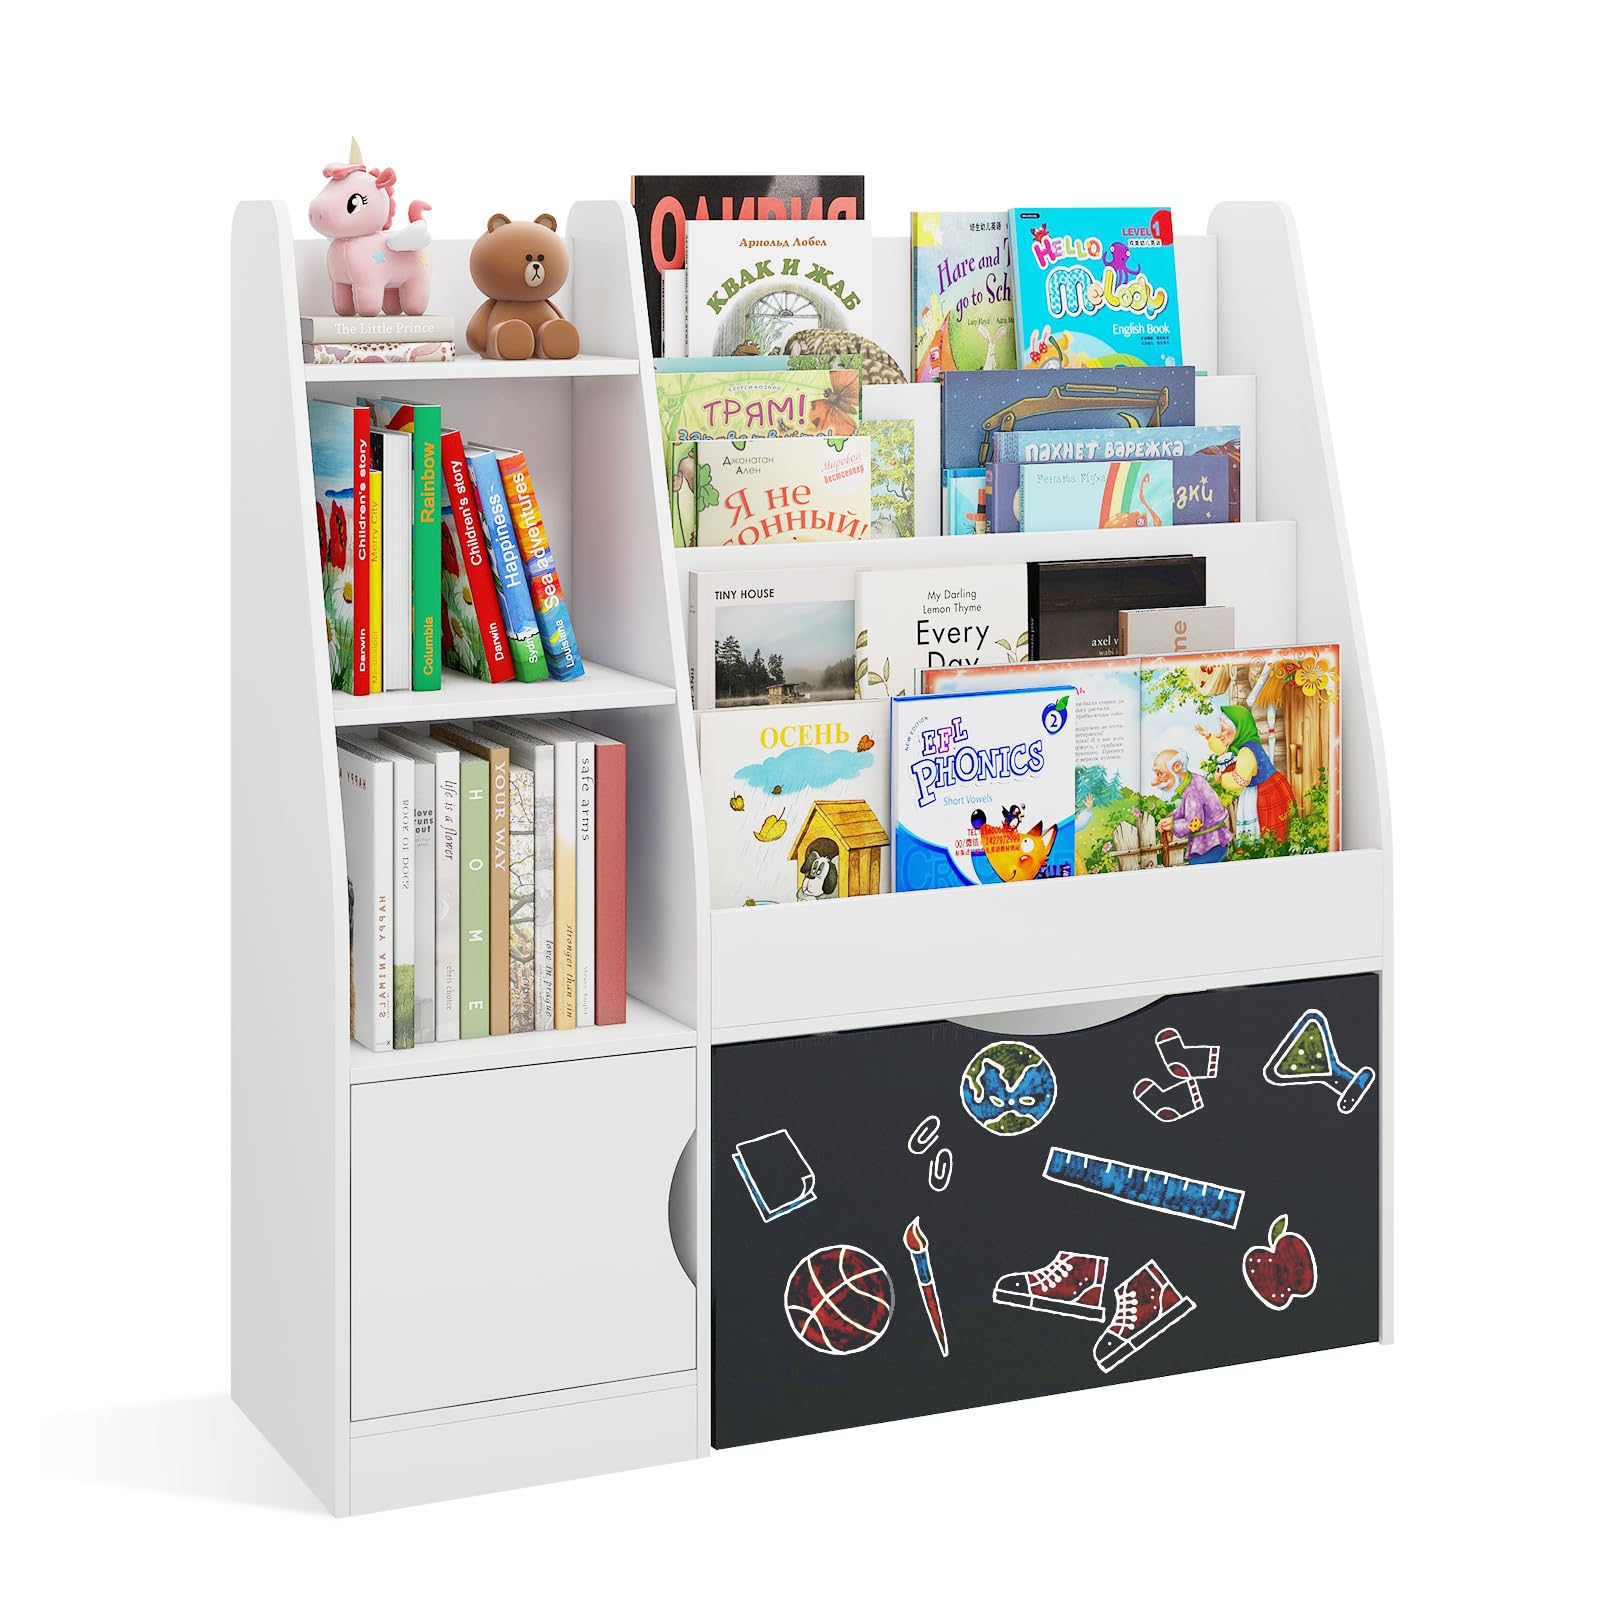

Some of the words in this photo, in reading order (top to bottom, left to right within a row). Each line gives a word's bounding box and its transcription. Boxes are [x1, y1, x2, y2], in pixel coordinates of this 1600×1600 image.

[739, 238, 790, 248] Арнольд
[793, 236, 827, 247] Лобел
[1122, 227, 1151, 236] LEVEL
[1033, 237, 1101, 267] HELLO
[706, 259, 775, 315] КВАК
[781, 258, 801, 276] И
[804, 262, 862, 311] ЖАБ
[937, 257, 976, 295] Hare
[978, 246, 1000, 270] and
[956, 296, 969, 322] go
[971, 287, 983, 306] to
[335, 323, 357, 335] The
[360, 322, 393, 334] Little
[396, 322, 435, 334] Prince
[1112, 322, 1145, 338] English
[1147, 322, 1170, 335] Book
[703, 394, 806, 428] ТРЯМ!
[359, 438, 368, 478] story
[722, 456, 775, 466] Джонатан
[420, 442, 435, 523] Rainbow
[451, 460, 466, 494] story
[358, 482, 367, 561] Children's
[512, 472, 555, 569] adventures
[724, 487, 756, 528] Я
[764, 484, 811, 510] не
[460, 497, 482, 566] Children's
[723, 510, 868, 545] онный!
[542, 573, 560, 609] Sea
[714, 590, 737, 600] TINY
[740, 588, 775, 600] HOUSE
[927, 591, 941, 602] My
[944, 588, 977, 600] Darling
[923, 604, 951, 614] Lemon
[954, 602, 982, 615] Thyme
[423, 616, 434, 676] Columbia
[488, 622, 505, 661] Darwin
[556, 619, 575, 668] Louisiana
[917, 619, 990, 651] Every
[1091, 635, 1111, 647] axel
[759, 722, 850, 750] ОСЕНЬ
[922, 716, 969, 757] EFL
[1050, 713, 1058, 728] 2
[440, 780, 457, 798] life
[581, 758, 595, 792] safe
[911, 739, 1045, 808] PHONICS
[444, 801, 455, 811] is
[495, 761, 506, 822] YOUR
[943, 795, 964, 806] Short
[966, 793, 993, 804] Vowels
[415, 825, 431, 833] out
[581, 799, 590, 841] arms
[440, 824, 458, 861] flower
[495, 827, 506, 871] WAY
[469, 789, 484, 1010] HOME
[546, 940, 554, 960] love
[564, 925, 573, 968] stronger
[546, 965, 553, 976] in
[566, 973, 575, 998] than
[542, 980, 553, 1017] prague
